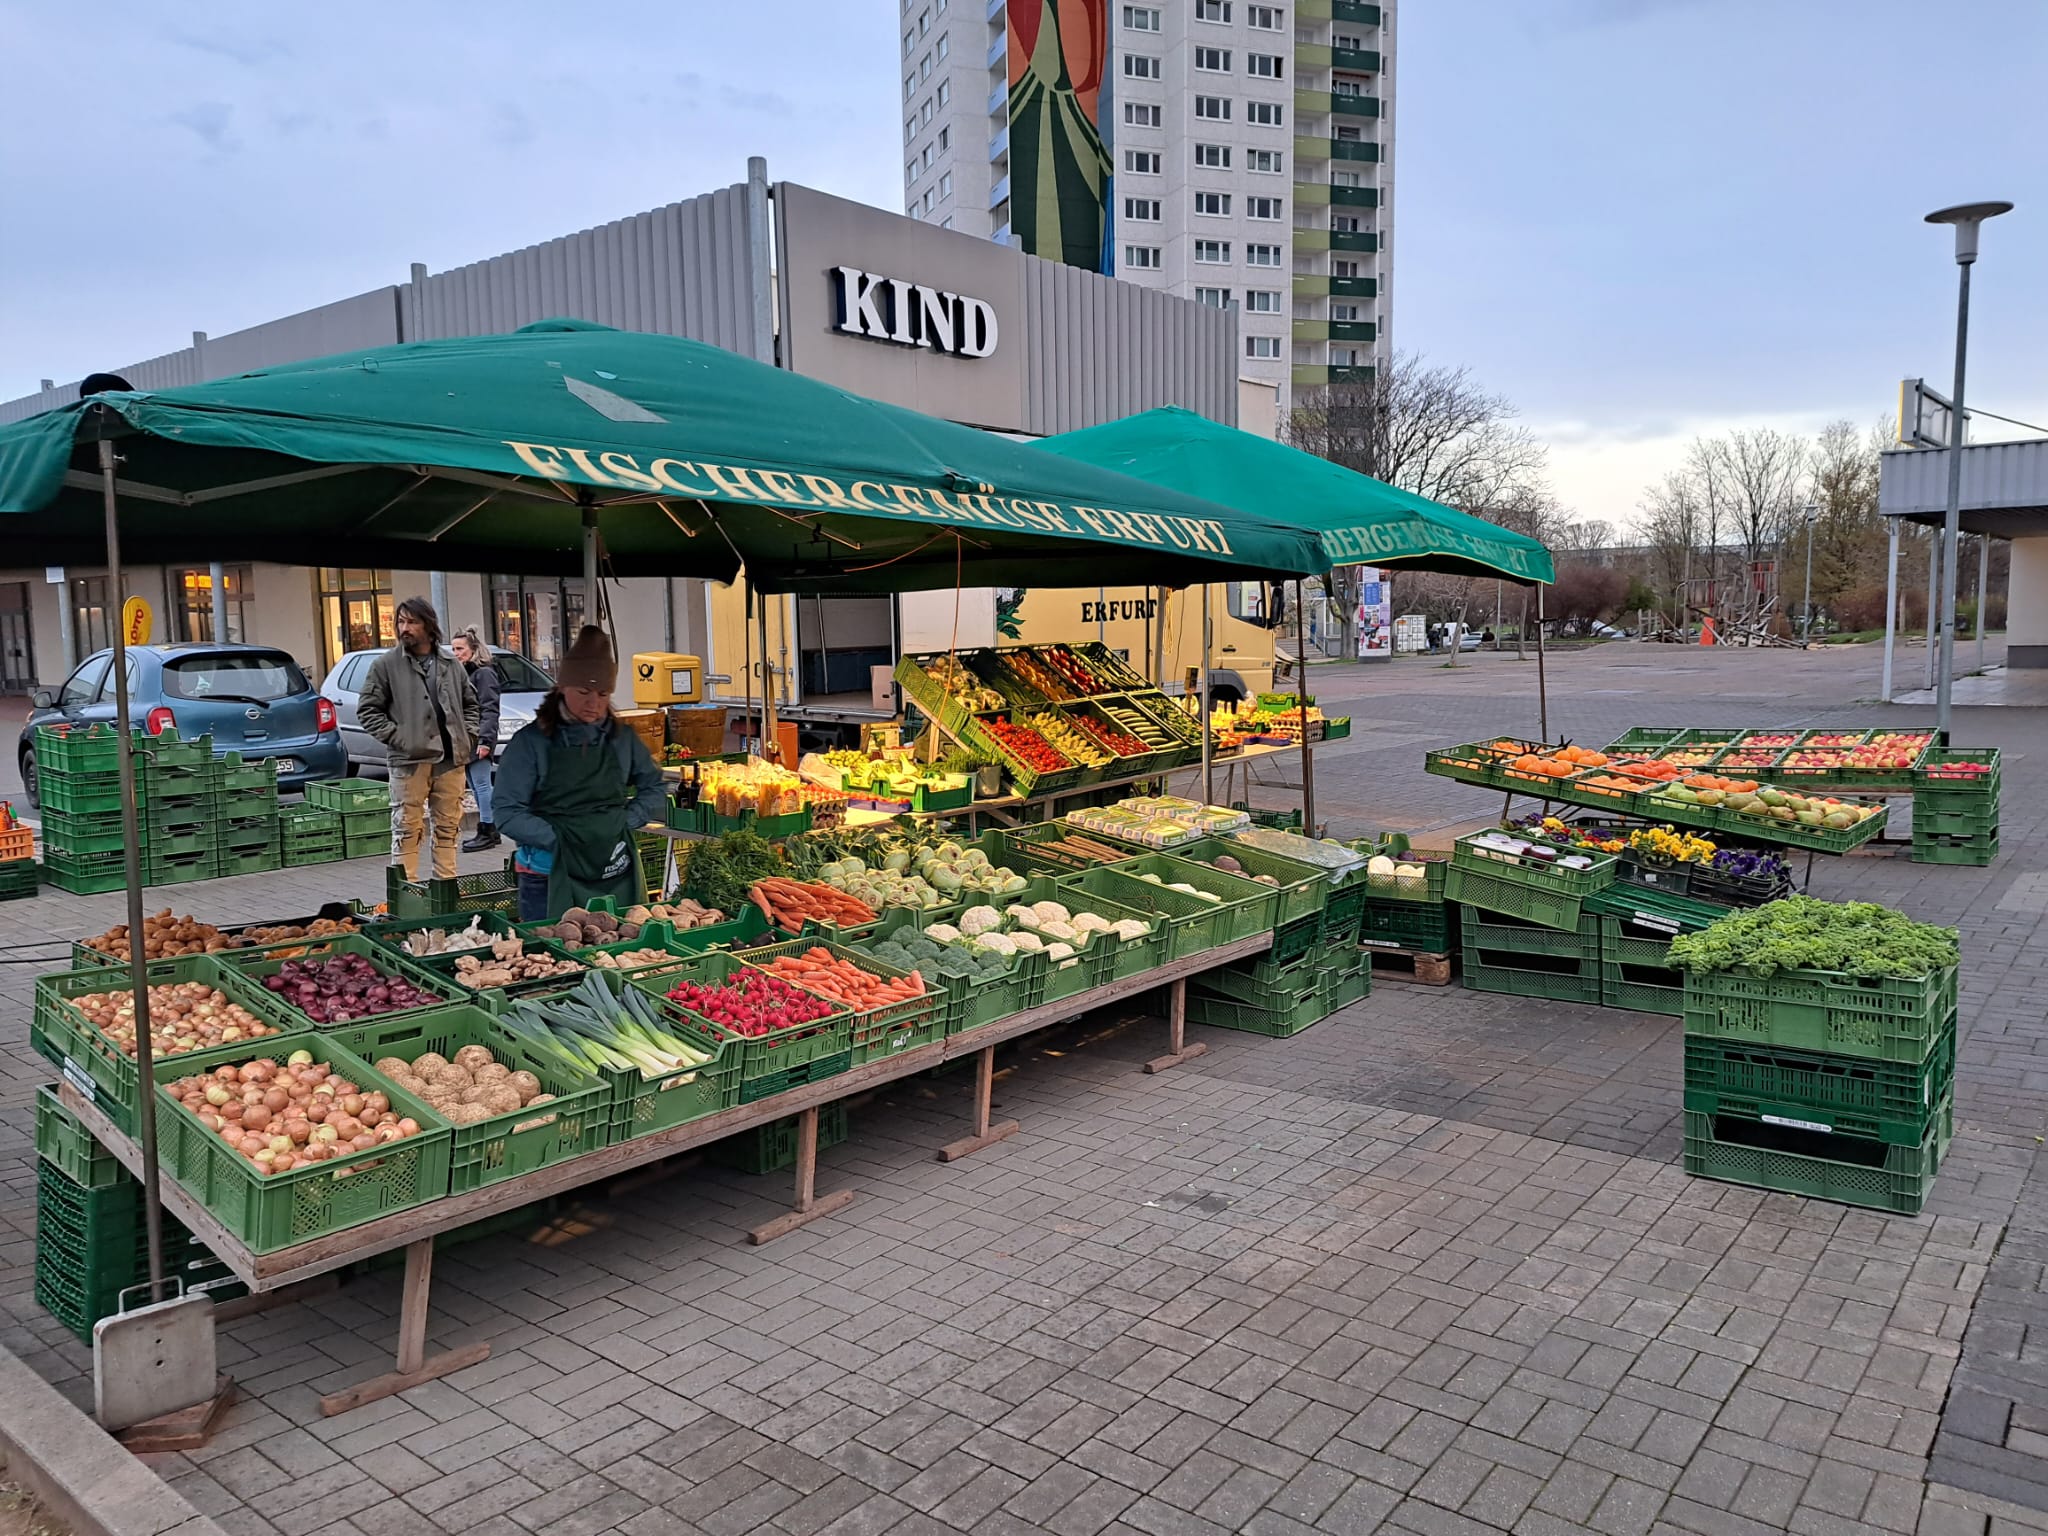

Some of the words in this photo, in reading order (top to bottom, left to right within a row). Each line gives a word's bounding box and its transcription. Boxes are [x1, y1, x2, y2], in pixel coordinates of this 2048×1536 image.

[835, 265, 999, 359] KIND
[1070, 505, 1234, 556] ERFURT
[1081, 599, 1158, 623] ERFURT
